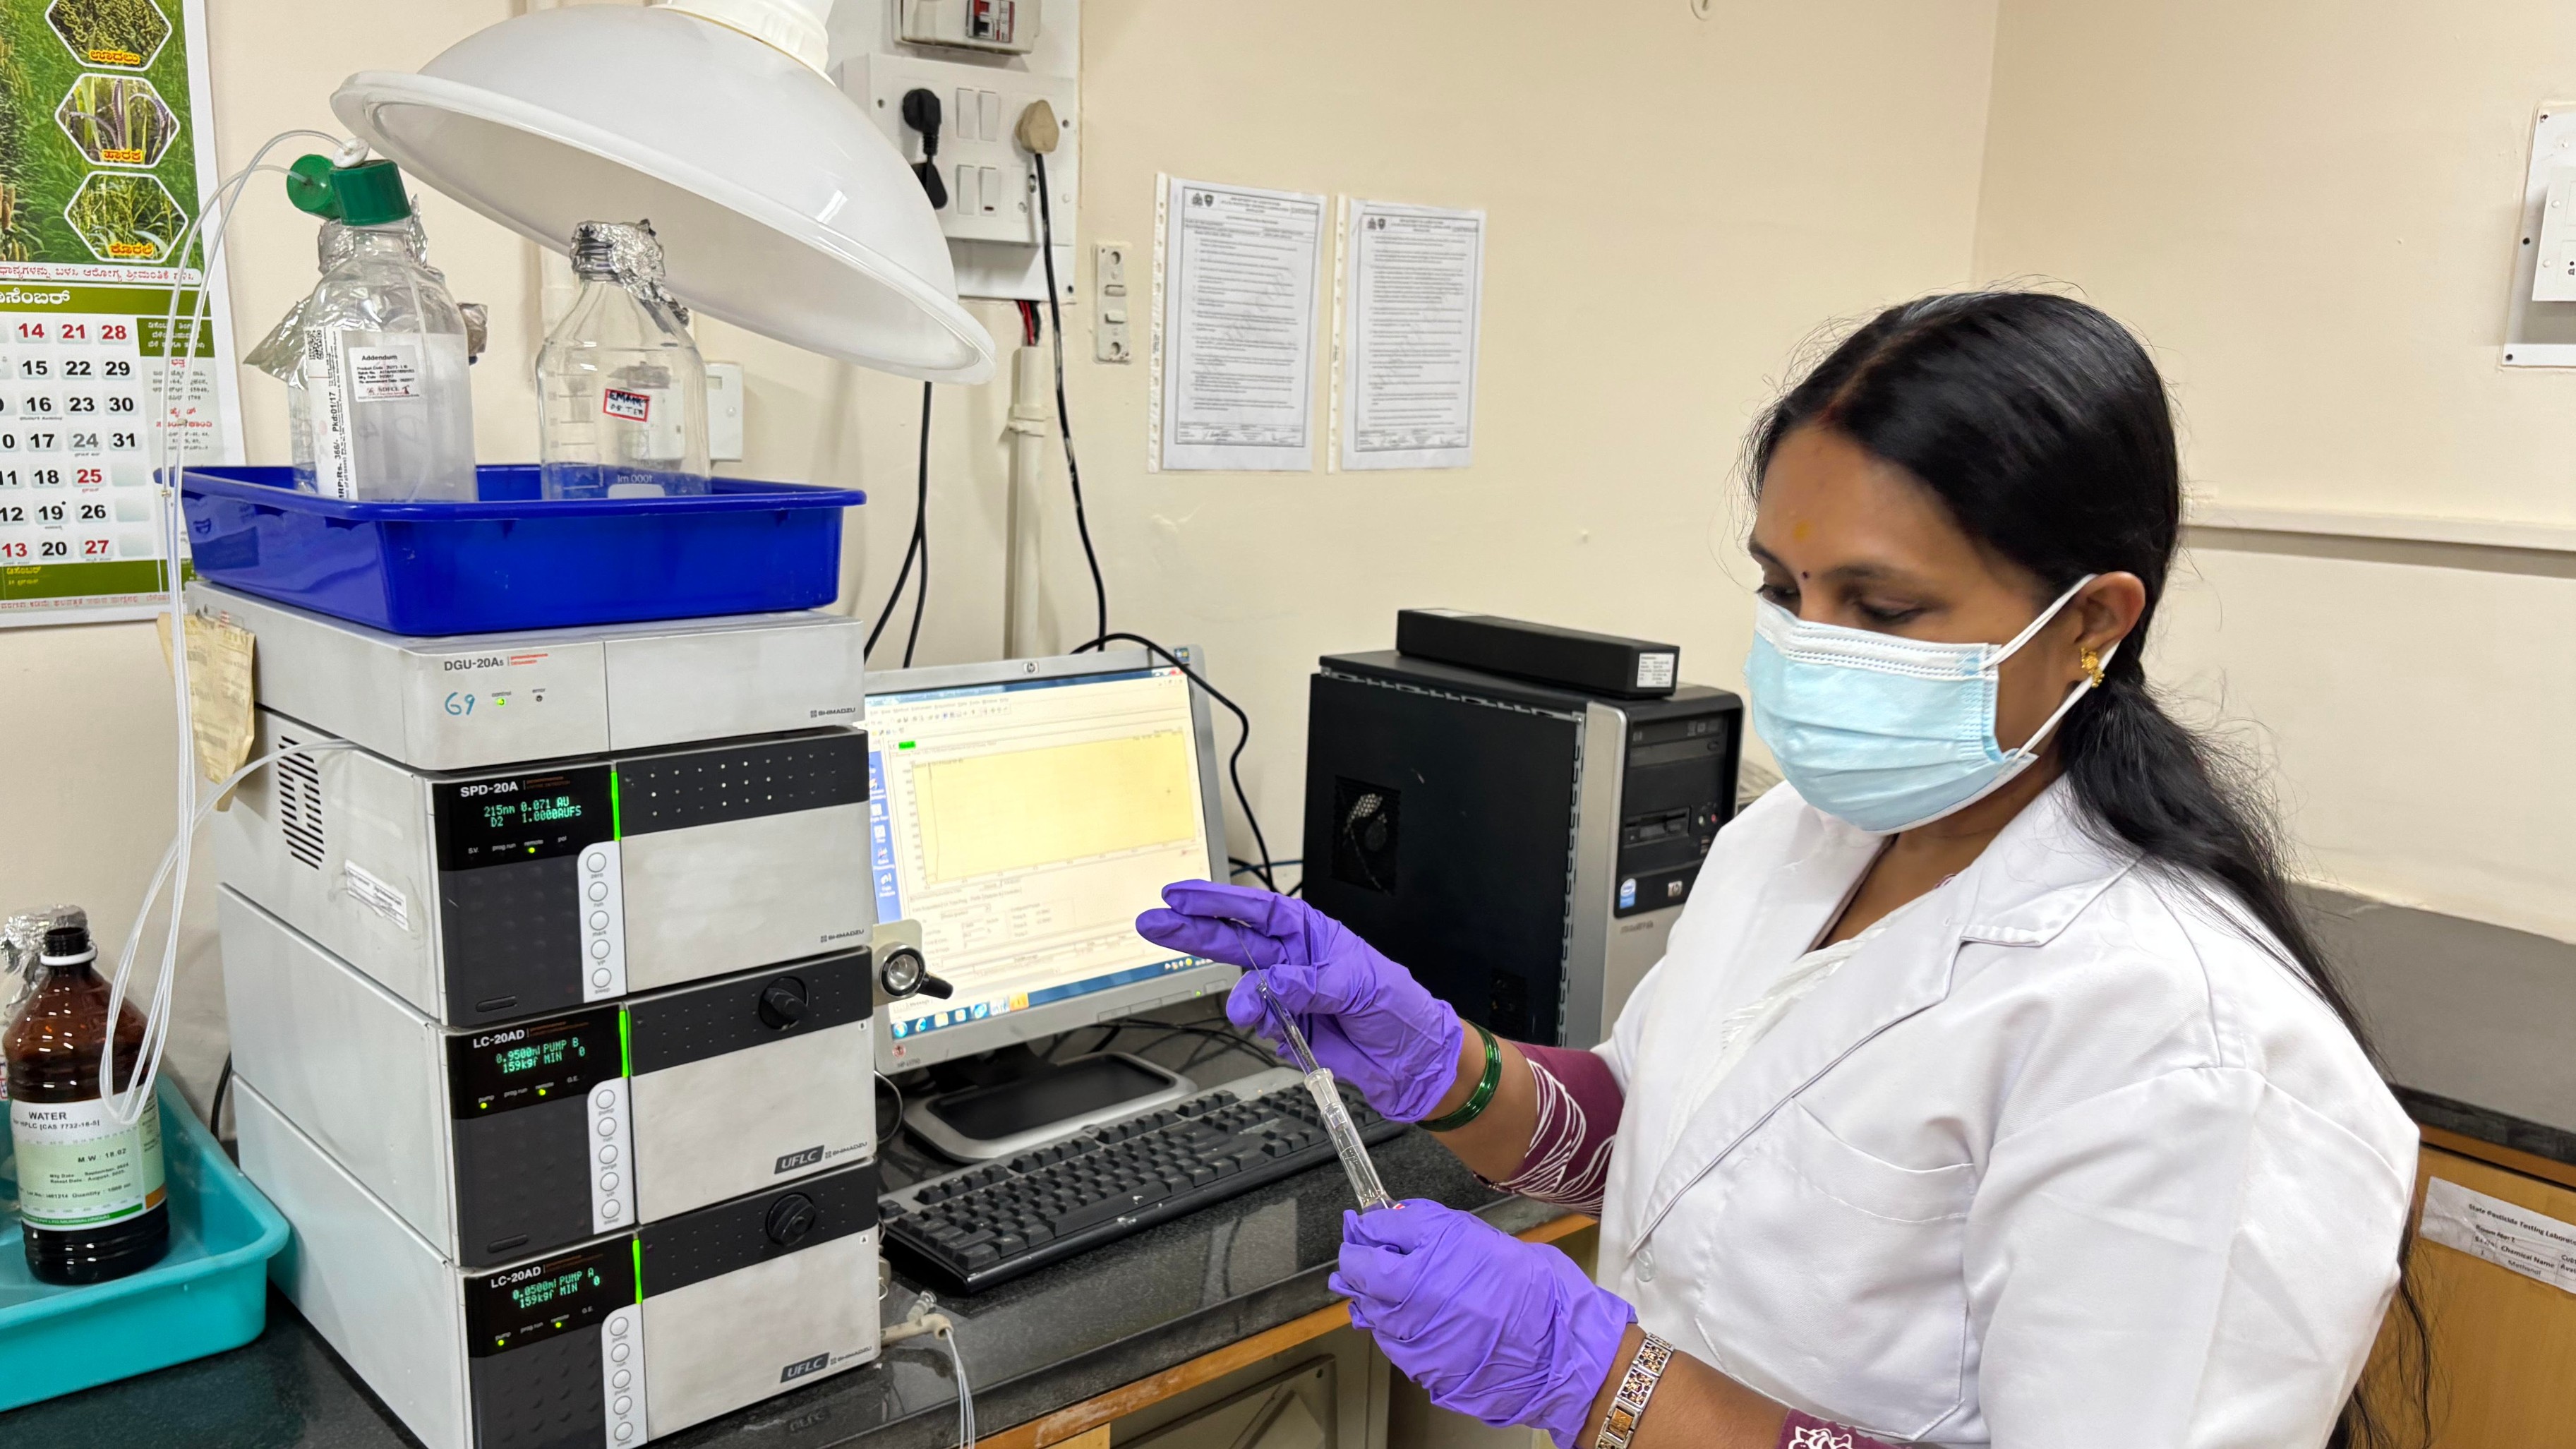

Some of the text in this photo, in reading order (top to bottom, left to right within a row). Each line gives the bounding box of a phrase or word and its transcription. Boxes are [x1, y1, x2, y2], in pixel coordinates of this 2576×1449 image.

[18, 323, 127, 340] 14 21 28
[22, 360, 131, 376] 15 22 29
[26, 397, 134, 411] 16 23 30
[328, 392, 339, 433] Pkd:01/17
[30, 433, 55, 448] 17
[73, 433, 99, 448] 24
[112, 433, 136, 448] 31
[34, 469, 59, 484] 18
[76, 469, 102, 483] 25
[0, 504, 107, 522] 12 19 26
[1, 539, 109, 558] 13 20 27
[818, 707, 855, 716] SHIMADZU
[460, 781, 519, 798] SPD-20A
[483, 796, 570, 817] 215nm 0.071 AU
[490, 817, 504, 828] D2
[828, 928, 865, 941] SHIMADZU
[473, 1029, 525, 1049] LC-20AD
[543, 1040, 567, 1054] PUMP
[572, 1037, 579, 1048] B
[502, 1046, 586, 1074] 159kgf MIN 0
[478, 1095, 495, 1103] pump
[28, 1112, 67, 1121] WATER
[105, 1148, 127, 1158] 18.02
[781, 1141, 867, 1170] UFLC SHIMADZU
[72, 1190, 101, 1198] Quantity
[2468, 1203, 2545, 1236] State Pesticide Testing
[2476, 1224, 2496, 1236] Room
[2500, 1245, 2555, 1268] Chemical Name
[2508, 1259, 2541, 1276] Methanol
[490, 1265, 541, 1289] LC-20AD
[559, 1271, 583, 1286] PUMP
[587, 1267, 594, 1278] A
[519, 1275, 600, 1309] 159kgf MIN 0
[495, 1331, 512, 1341] pump
[787, 1357, 824, 1378] UFLC
